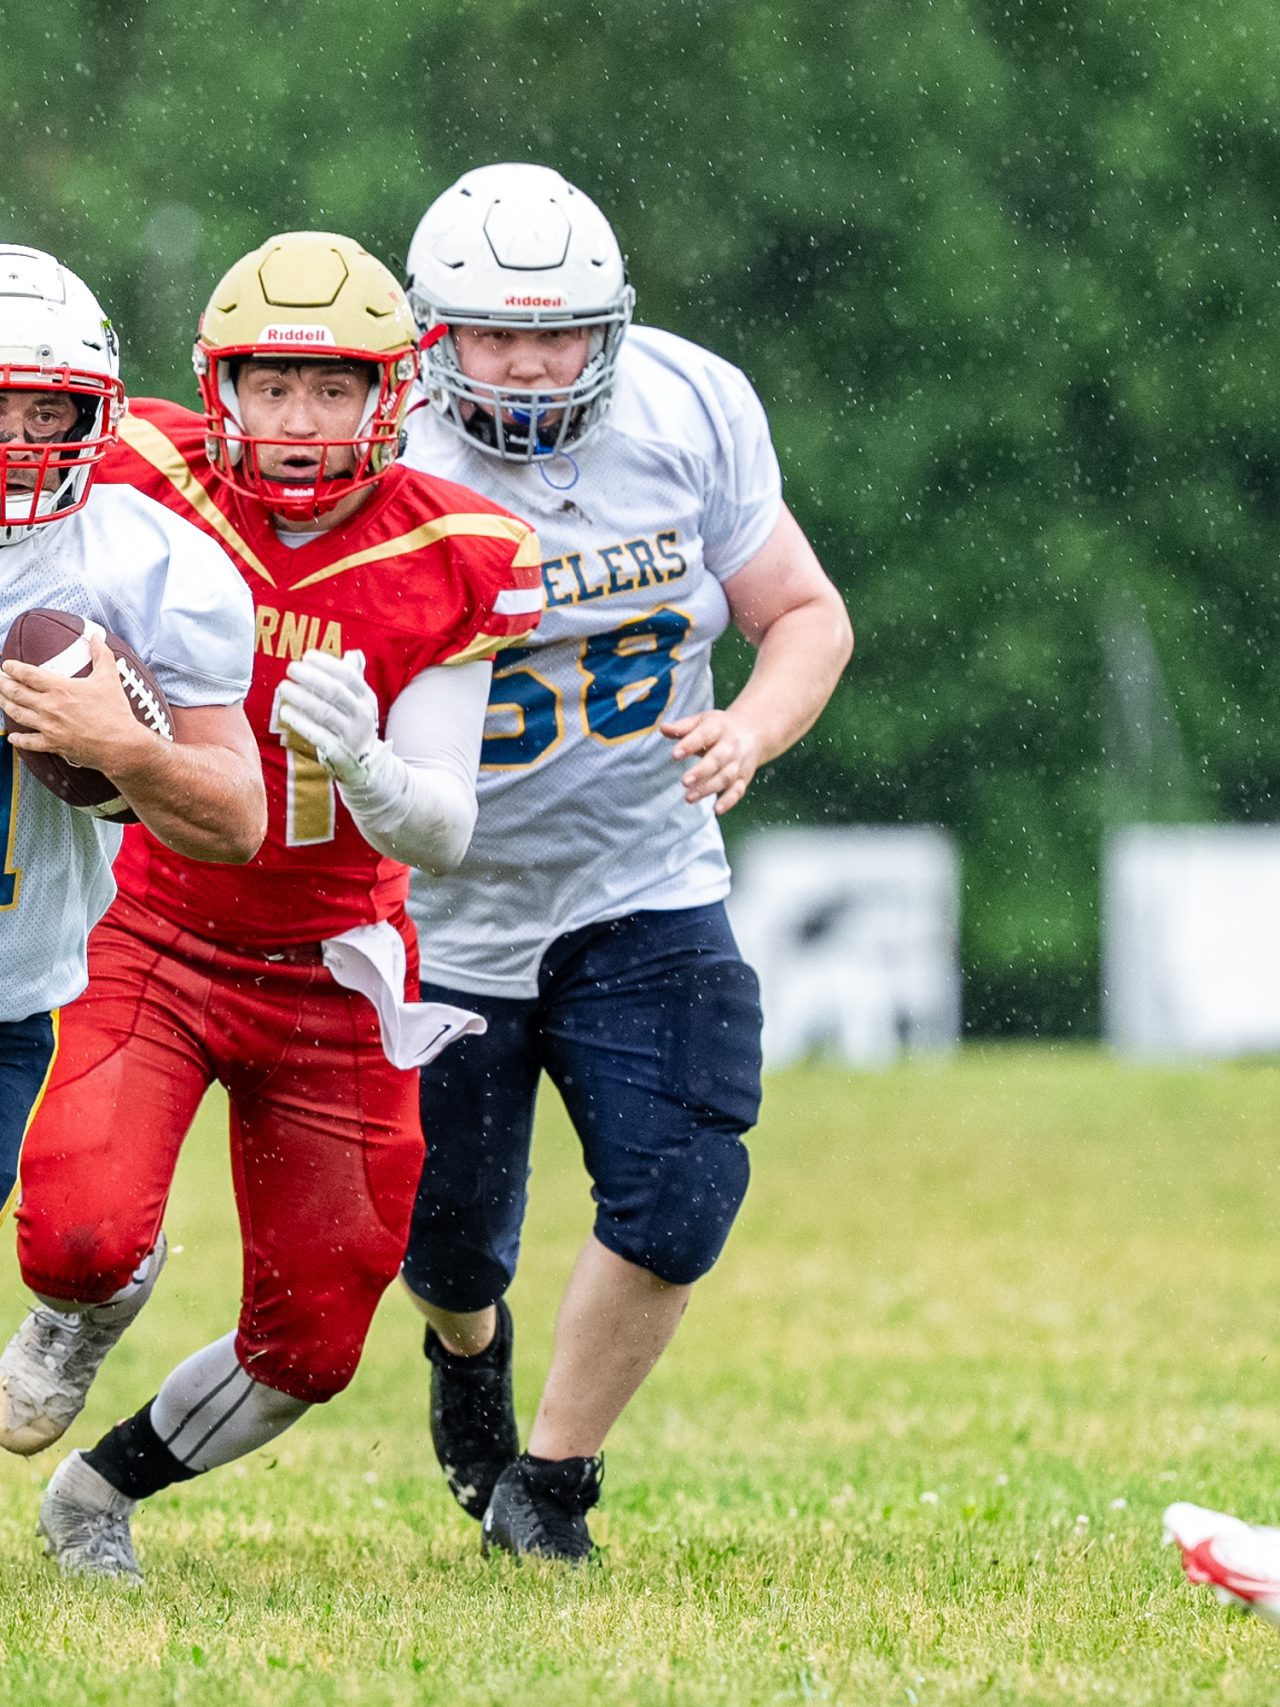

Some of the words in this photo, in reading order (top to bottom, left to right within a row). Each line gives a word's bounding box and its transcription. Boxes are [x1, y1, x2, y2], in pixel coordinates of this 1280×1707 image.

[268, 329, 325, 341] Riddell
[541, 529, 688, 611] ELERS
[255, 605, 342, 661] RNIA
